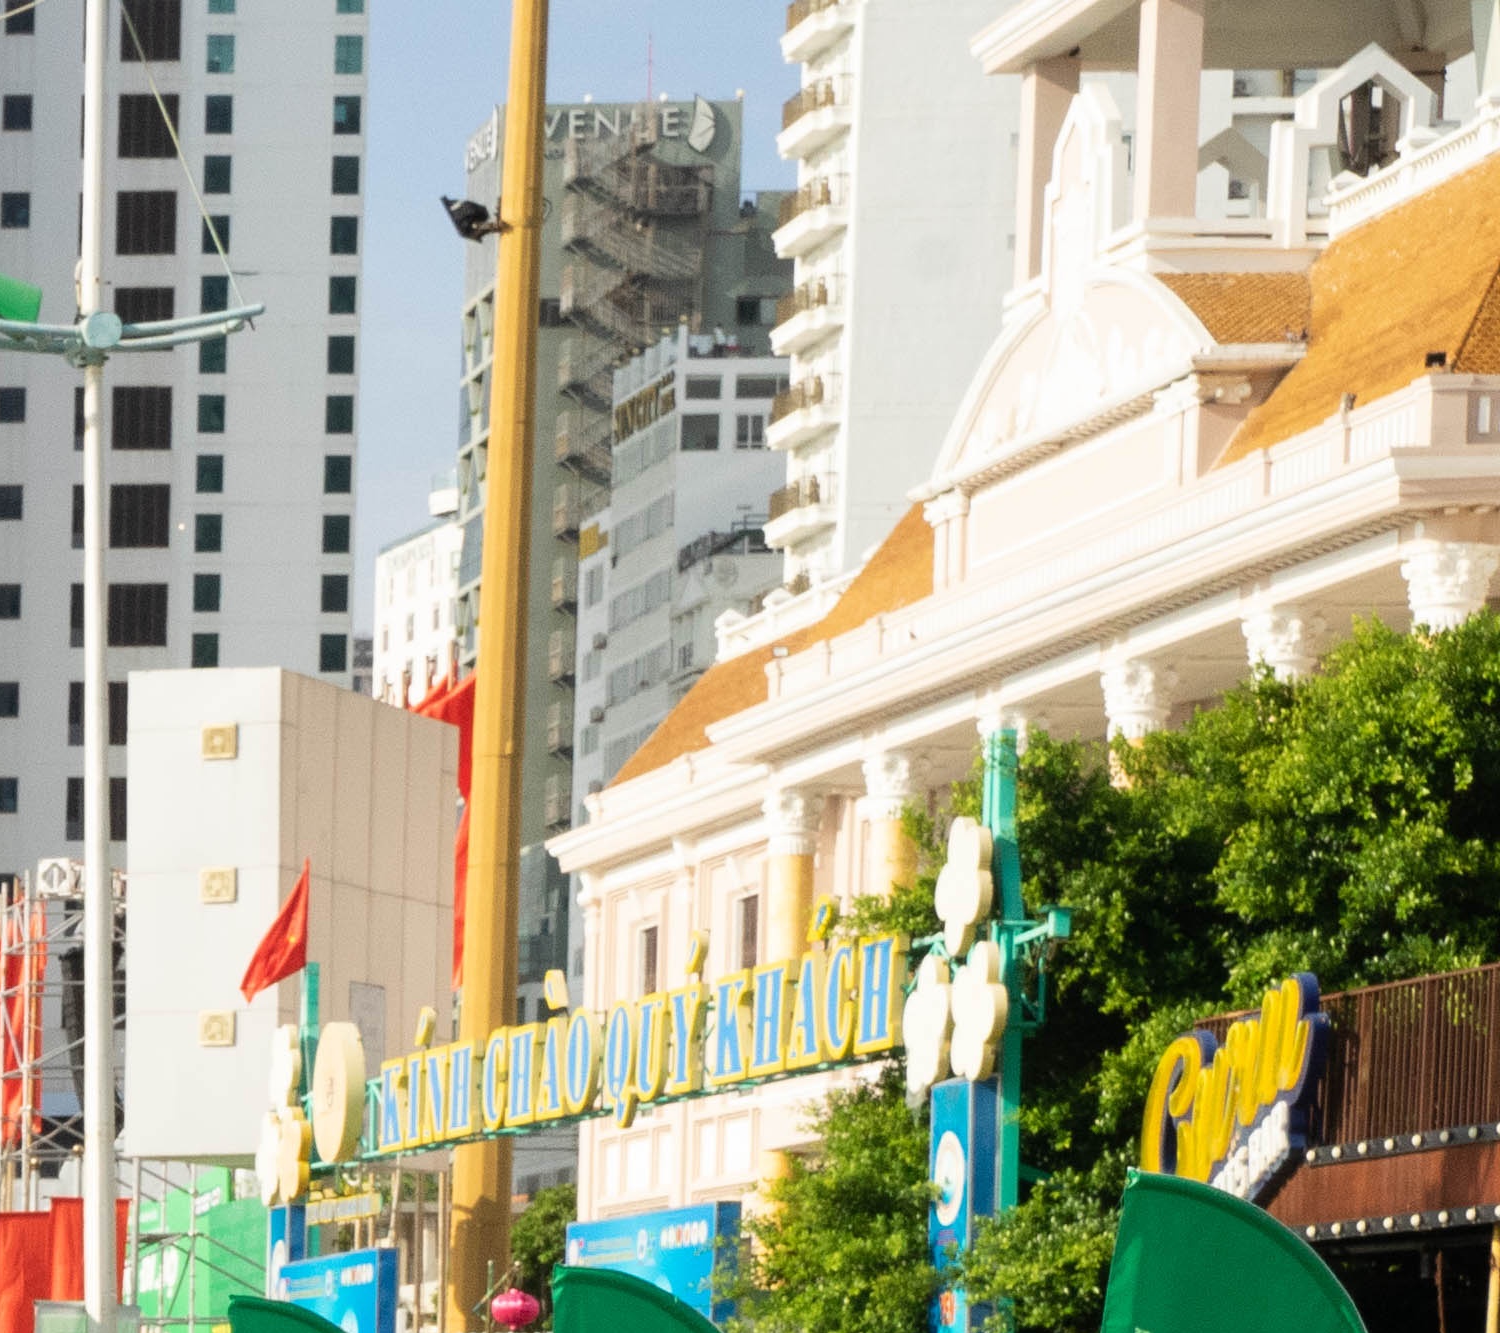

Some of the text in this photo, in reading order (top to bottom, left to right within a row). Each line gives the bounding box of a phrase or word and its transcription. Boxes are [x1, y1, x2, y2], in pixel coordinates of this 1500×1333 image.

[379, 895, 905, 1153] KÍNH CHÀO QUÝ KHÁCH
